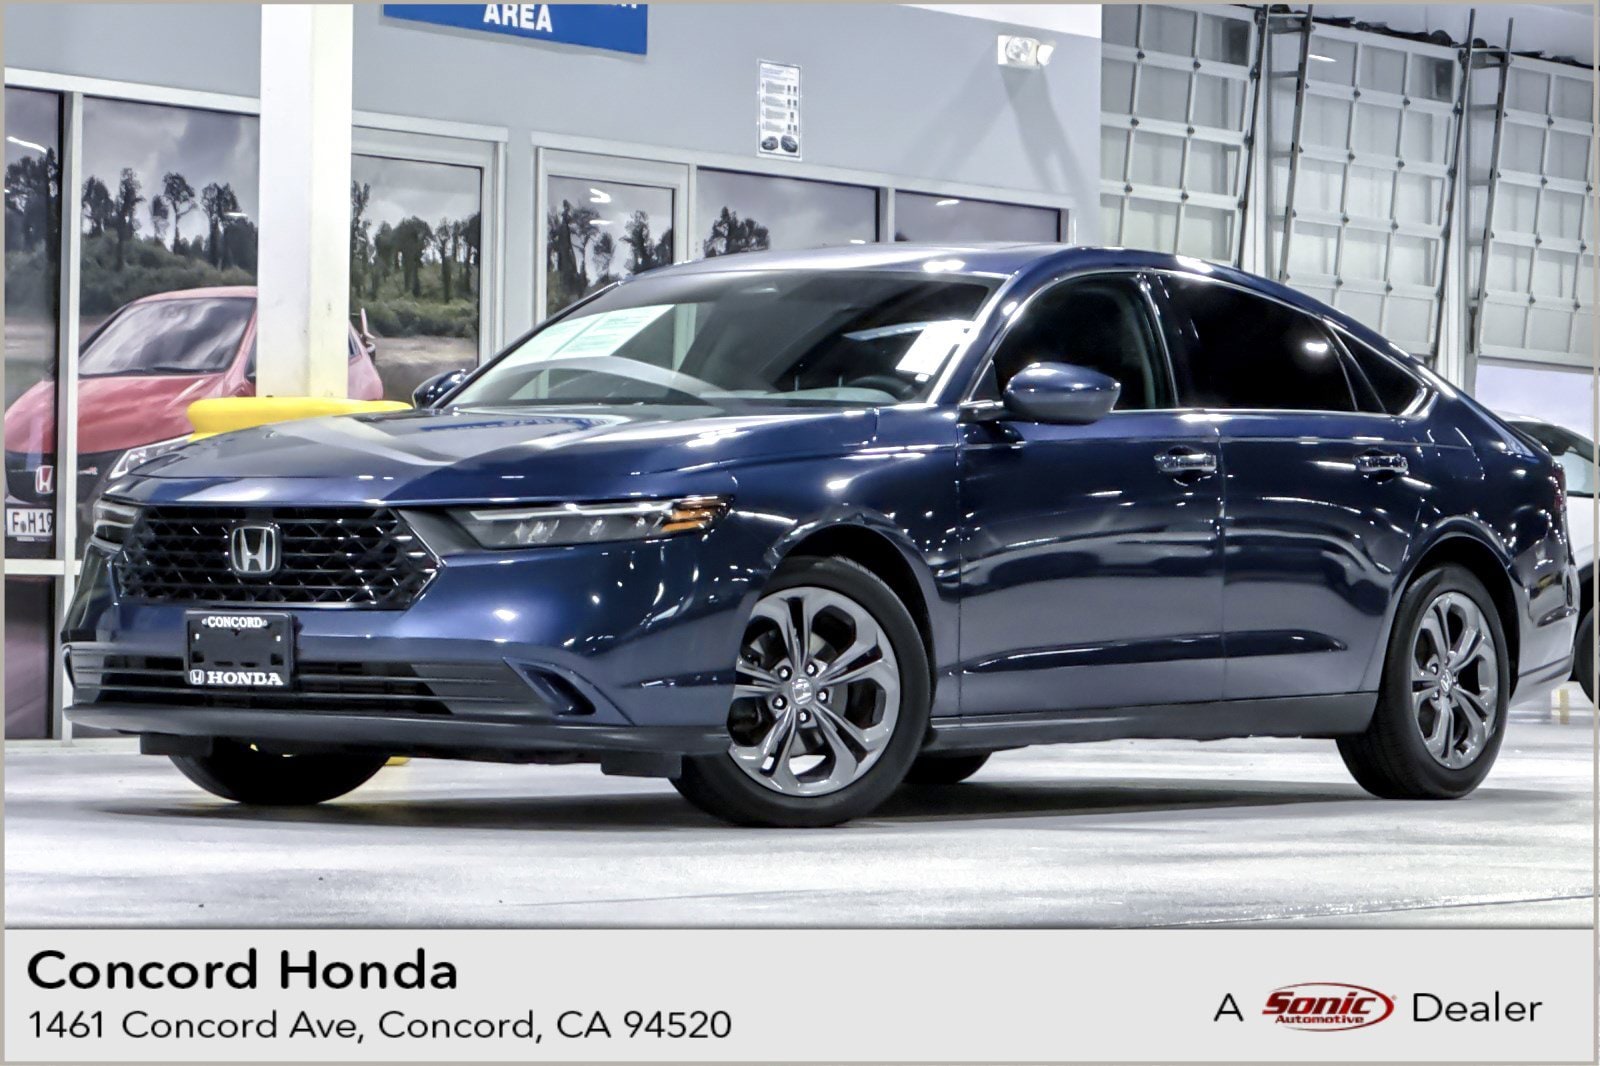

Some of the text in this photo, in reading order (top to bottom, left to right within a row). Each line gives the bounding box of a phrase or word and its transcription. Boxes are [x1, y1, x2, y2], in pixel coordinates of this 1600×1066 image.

[483, 4, 553, 33] AREA
[207, 616, 263, 628] CONCORD
[206, 671, 284, 686] HONDA
